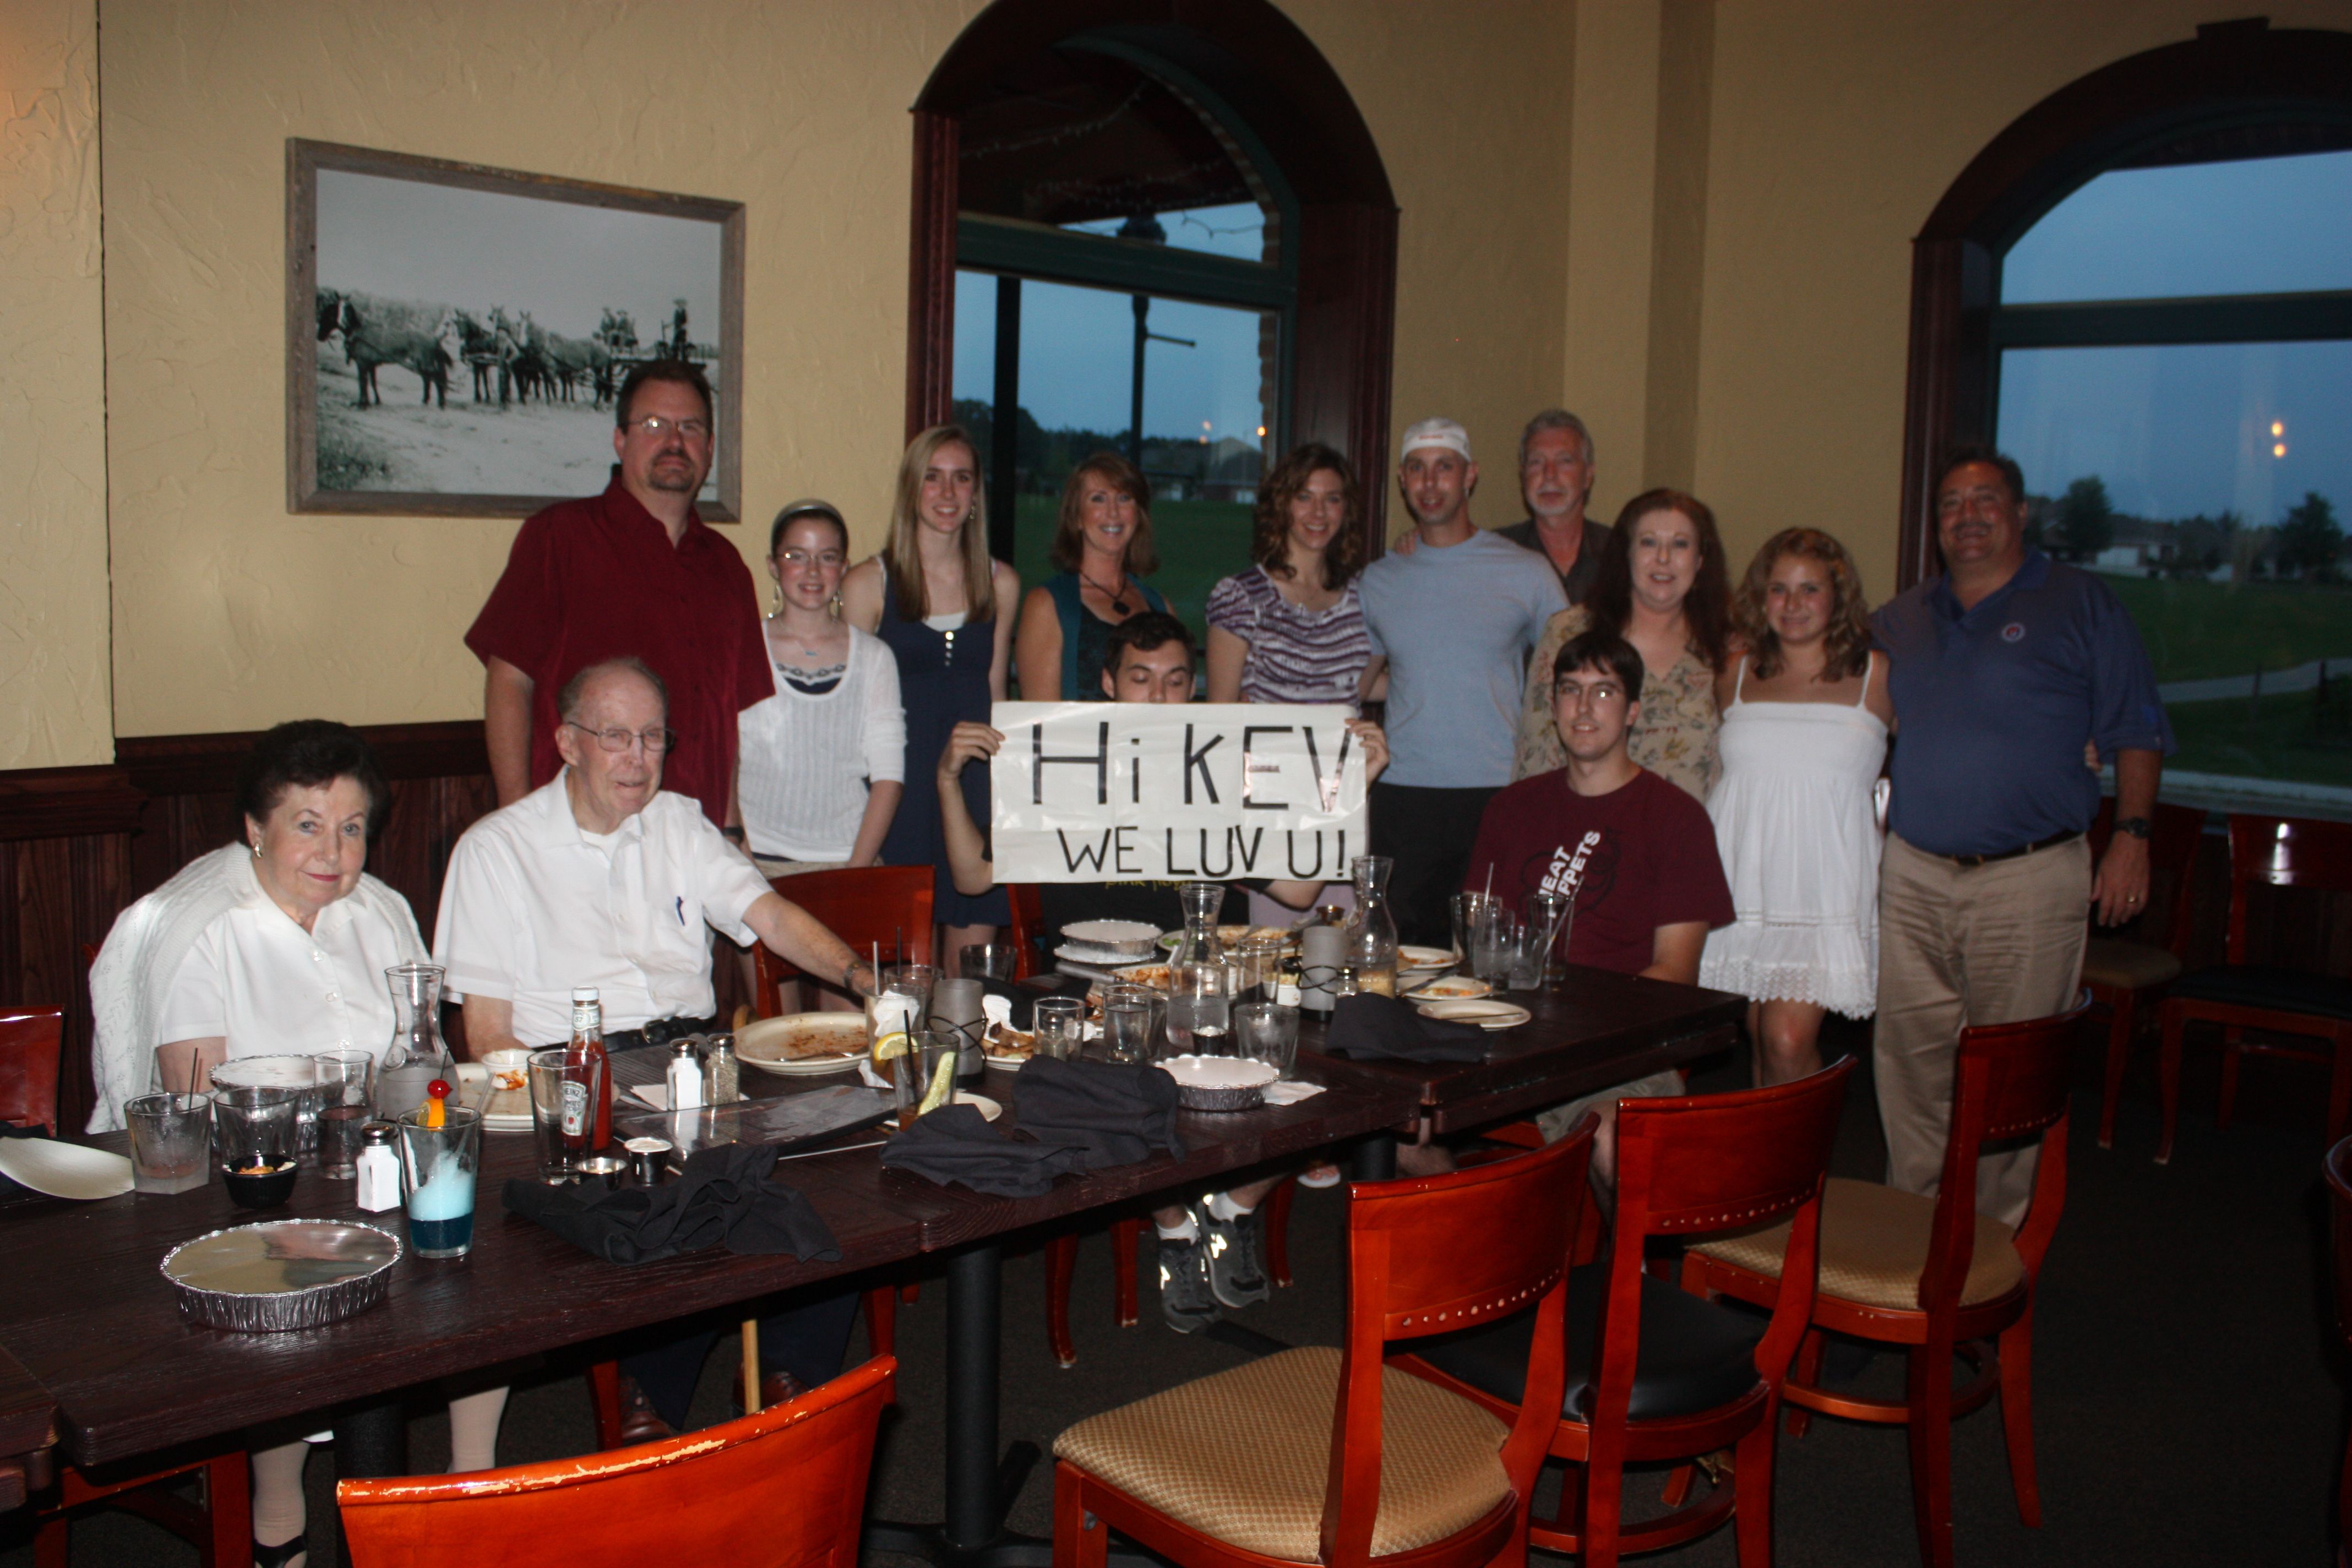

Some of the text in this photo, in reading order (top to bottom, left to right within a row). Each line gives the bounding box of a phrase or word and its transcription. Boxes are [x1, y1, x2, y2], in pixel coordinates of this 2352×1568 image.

[1032, 722, 1352, 813] Hi KEV
[1057, 825, 1346, 880] WE LUV U!
